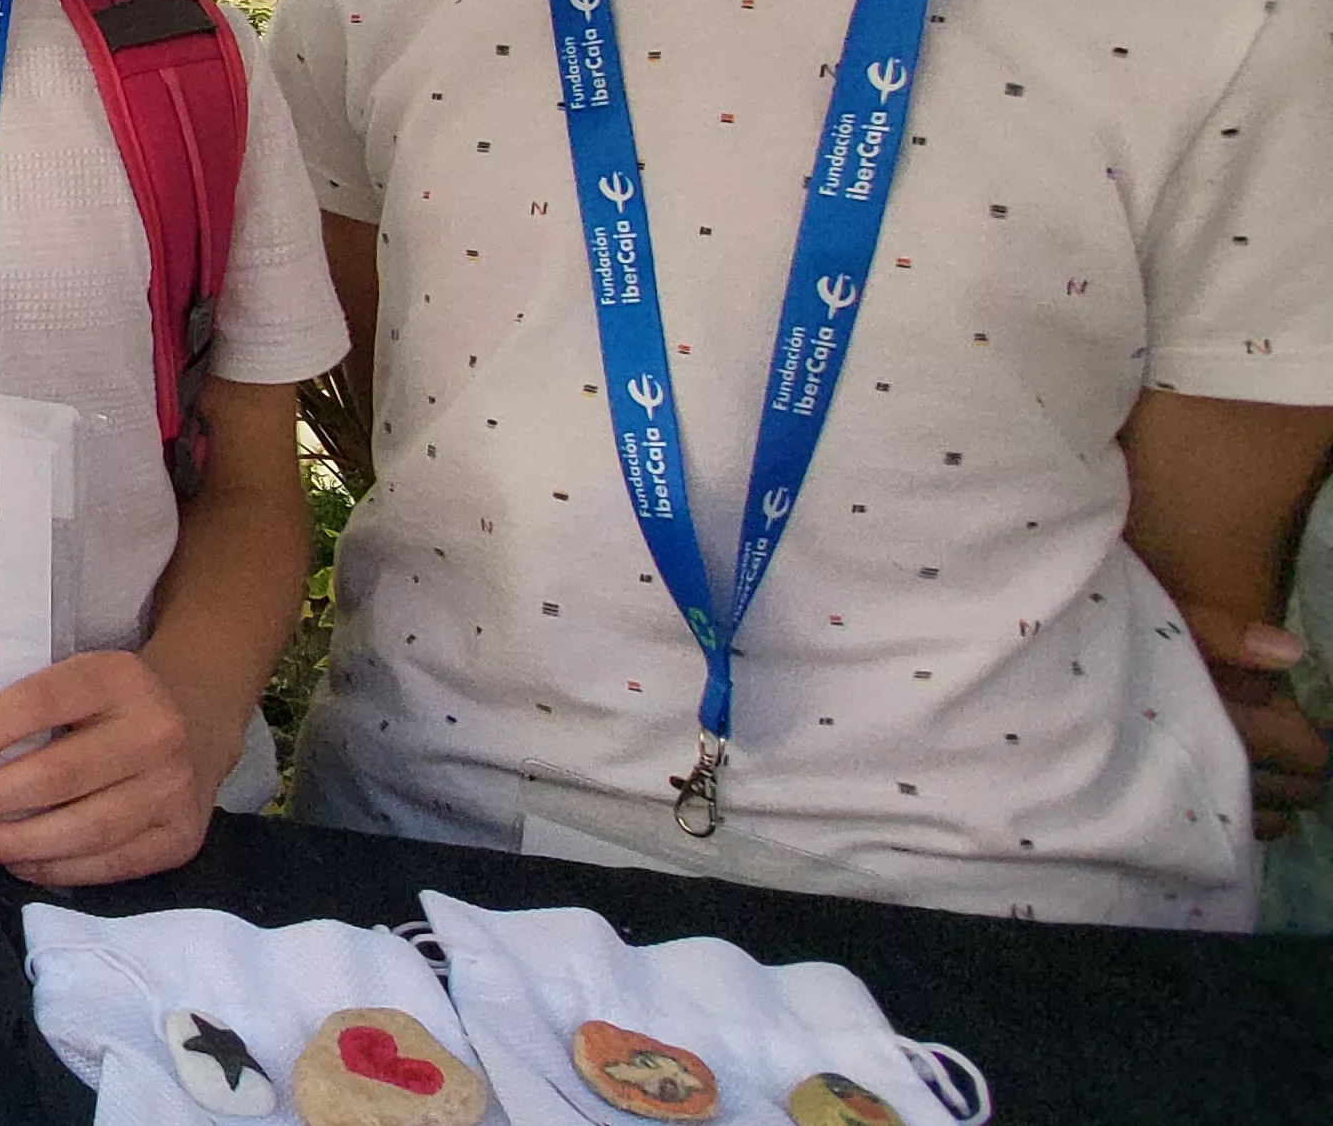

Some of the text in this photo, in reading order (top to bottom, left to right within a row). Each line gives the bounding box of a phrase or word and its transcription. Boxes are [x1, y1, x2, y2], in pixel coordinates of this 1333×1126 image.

[562, 37, 583, 111] Fundación
[582, 28, 610, 107] iberCaja
[817, 112, 858, 197] Fundación
[844, 110, 891, 202] iberCaja
[591, 226, 617, 306] Fundación
[617, 220, 642, 305] iberCaja
[772, 326, 807, 413] Fundación
[793, 326, 837, 417] iberCaja
[623, 431, 653, 519] Fundación
[641, 426, 674, 520] iberCaja
